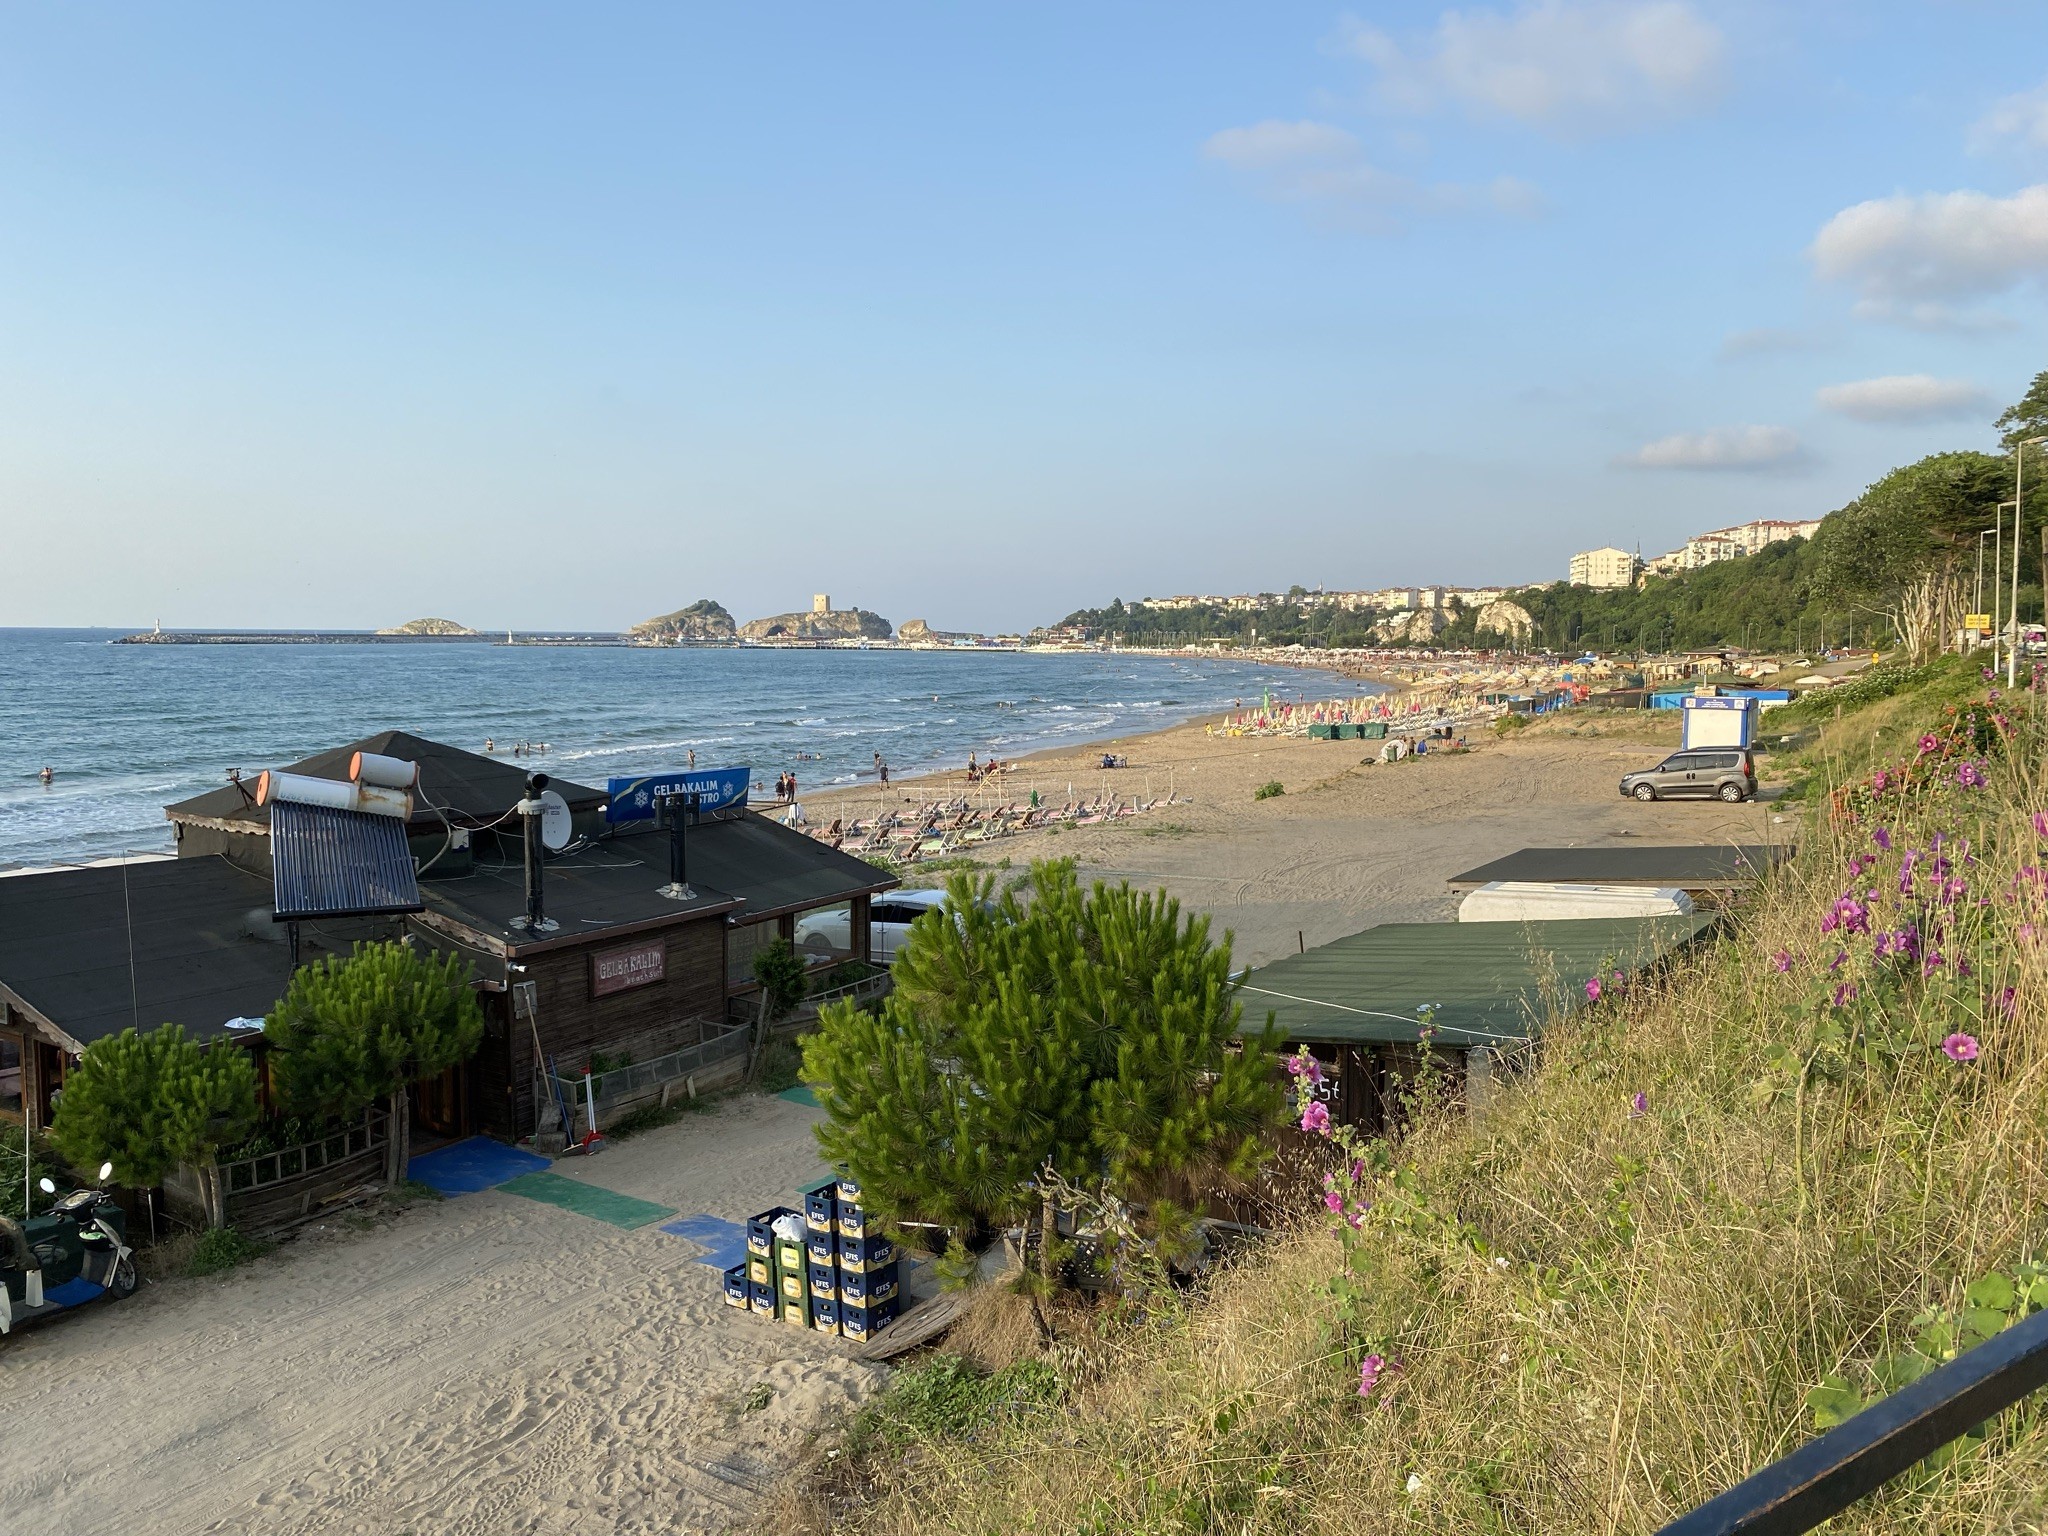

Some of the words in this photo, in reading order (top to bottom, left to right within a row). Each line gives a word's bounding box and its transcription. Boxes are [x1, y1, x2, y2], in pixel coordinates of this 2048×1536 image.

[654, 785, 670, 796] GEL
[674, 780, 718, 792] BAKALIM
[843, 1182, 856, 1192] EFES
[811, 1211, 824, 1220] EFES
[844, 1217, 858, 1227] EFES
[752, 1236, 765, 1245] EFES
[814, 1246, 826, 1256] EFES
[874, 1248, 889, 1259] EFES
[846, 1252, 859, 1262] EFES
[816, 1280, 829, 1289] EFES
[876, 1282, 890, 1294] EFES
[730, 1288, 742, 1298] EFES
[847, 1287, 860, 1296] EFES
[756, 1297, 769, 1307] EFES
[820, 1314, 833, 1323] EFES
[877, 1316, 892, 1328] EFES
[848, 1321, 861, 1330] EFES
